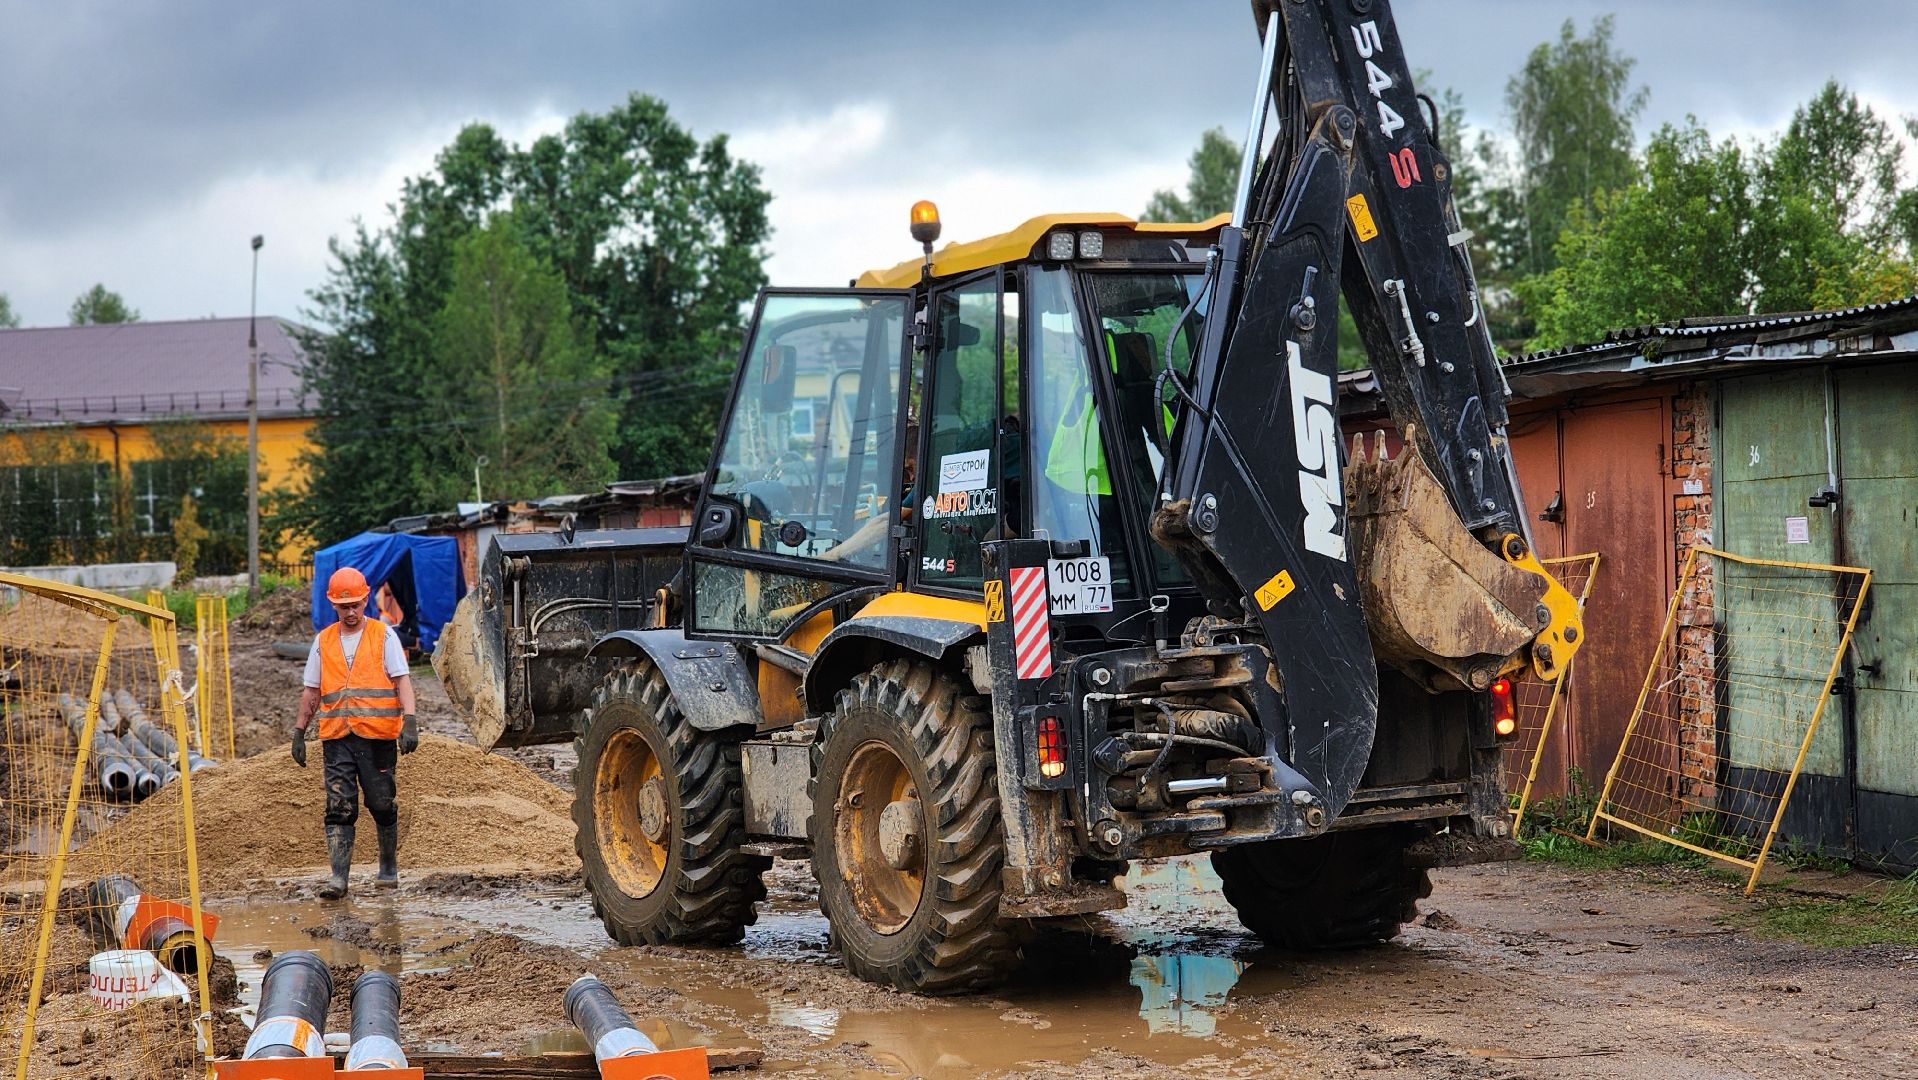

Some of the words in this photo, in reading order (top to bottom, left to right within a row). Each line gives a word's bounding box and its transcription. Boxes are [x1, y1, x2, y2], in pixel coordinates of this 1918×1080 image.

[1351, 20, 1405, 140] 544
[1388, 147, 1421, 189] S
[1286, 340, 1347, 563] MST
[1749, 445, 1760, 467] 36
[1586, 491, 1596, 509] 35
[922, 556, 945, 571] 544
[946, 559, 955, 573] S
[1055, 561, 1101, 583] 1008
[1087, 586, 1106, 603] 77
